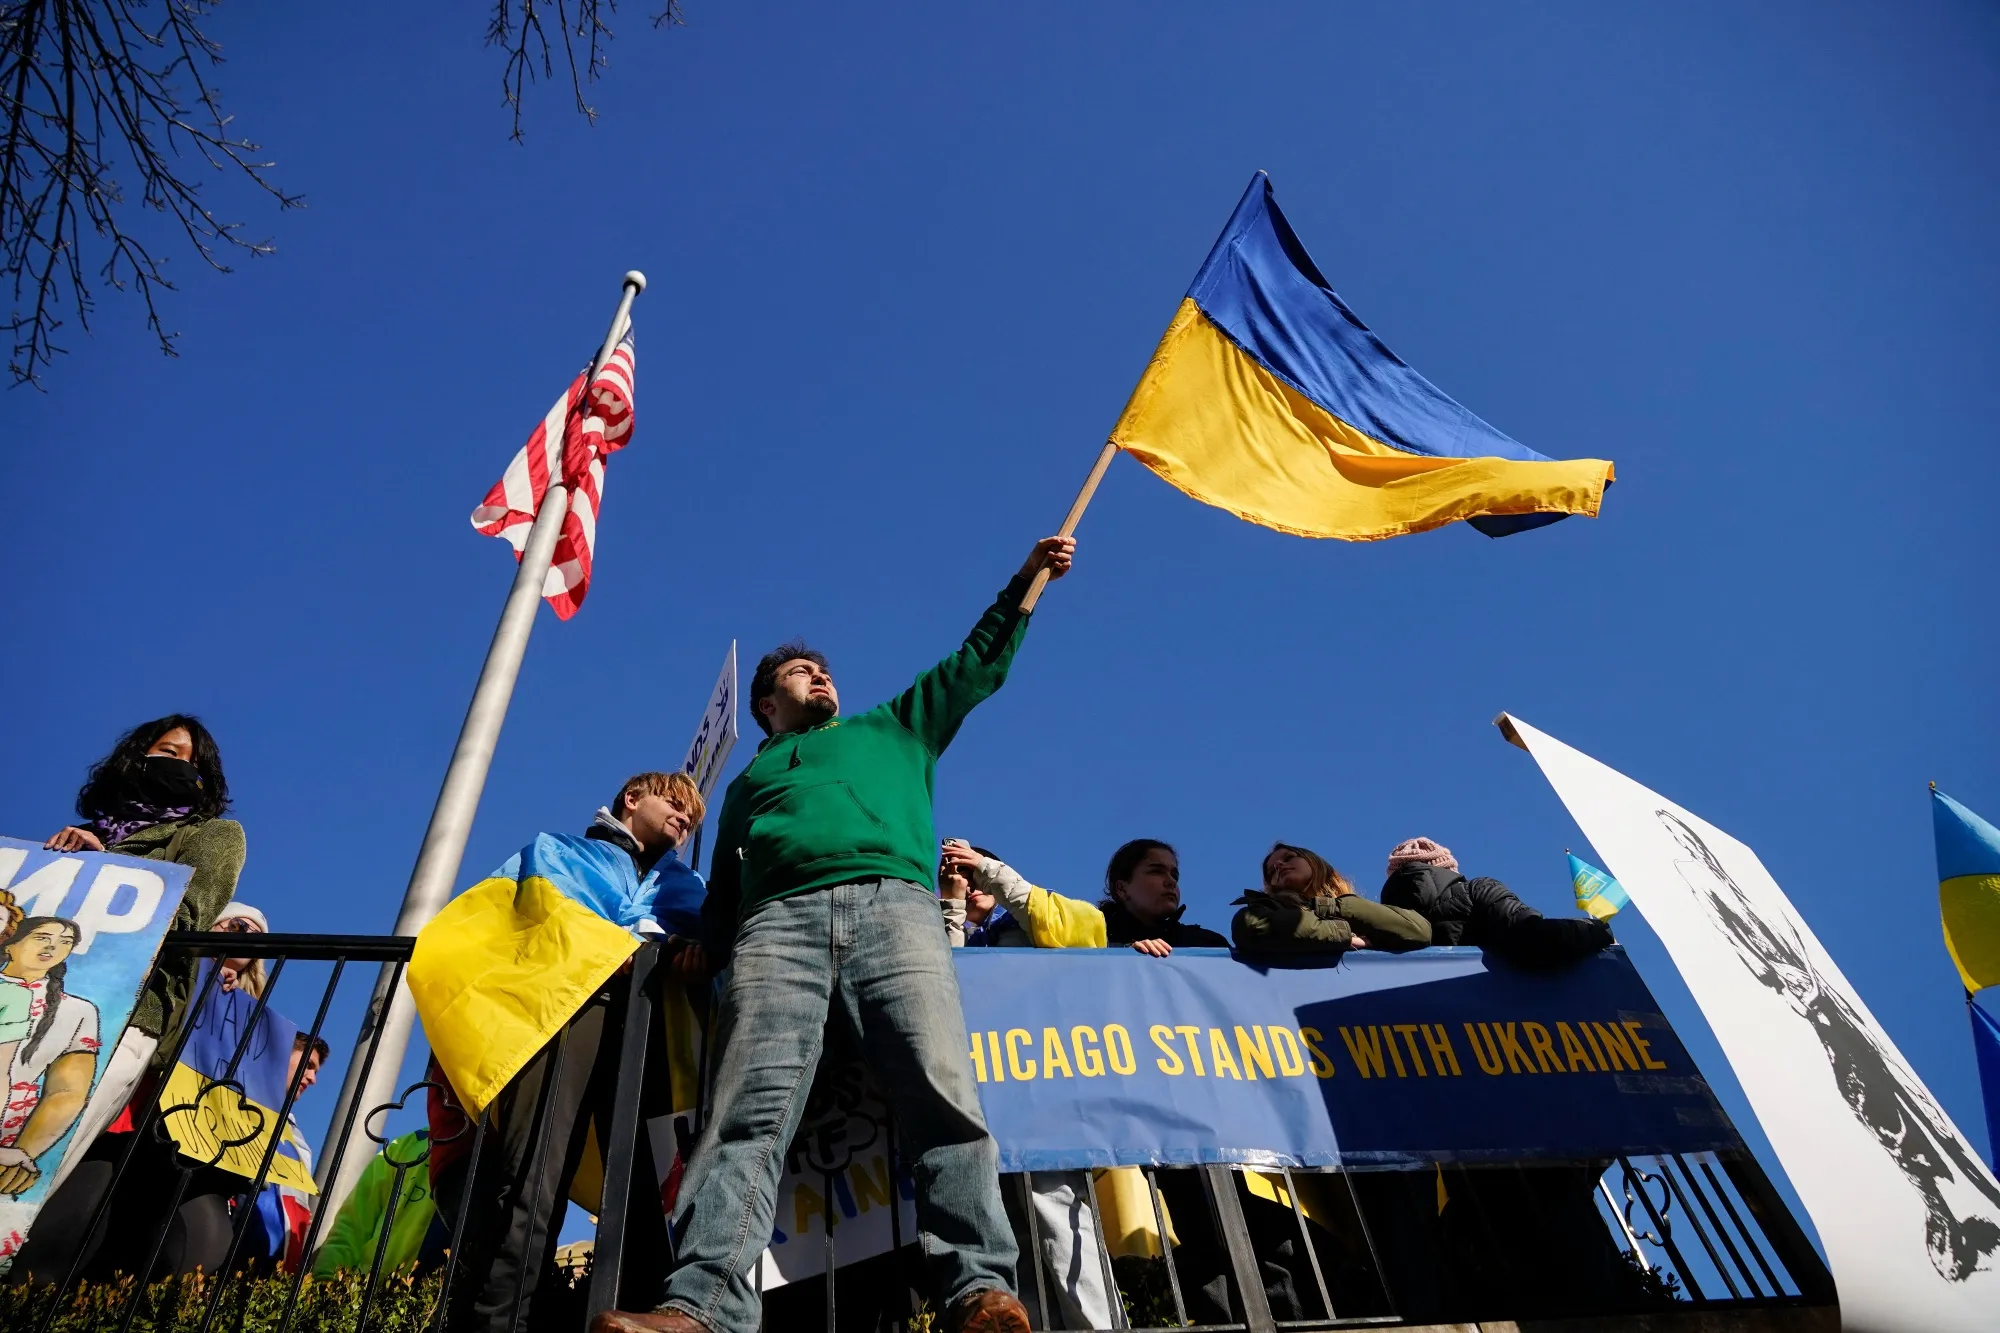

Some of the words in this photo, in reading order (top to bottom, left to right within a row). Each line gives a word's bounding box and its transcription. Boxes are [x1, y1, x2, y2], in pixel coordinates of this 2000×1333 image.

[686, 715, 710, 775] NDS
[969, 1024, 1137, 1083] HICAGO
[1149, 1024, 1335, 1081] STANDS
[1339, 1023, 1464, 1079] WITH
[1463, 1021, 1667, 1076] UKRAINE
